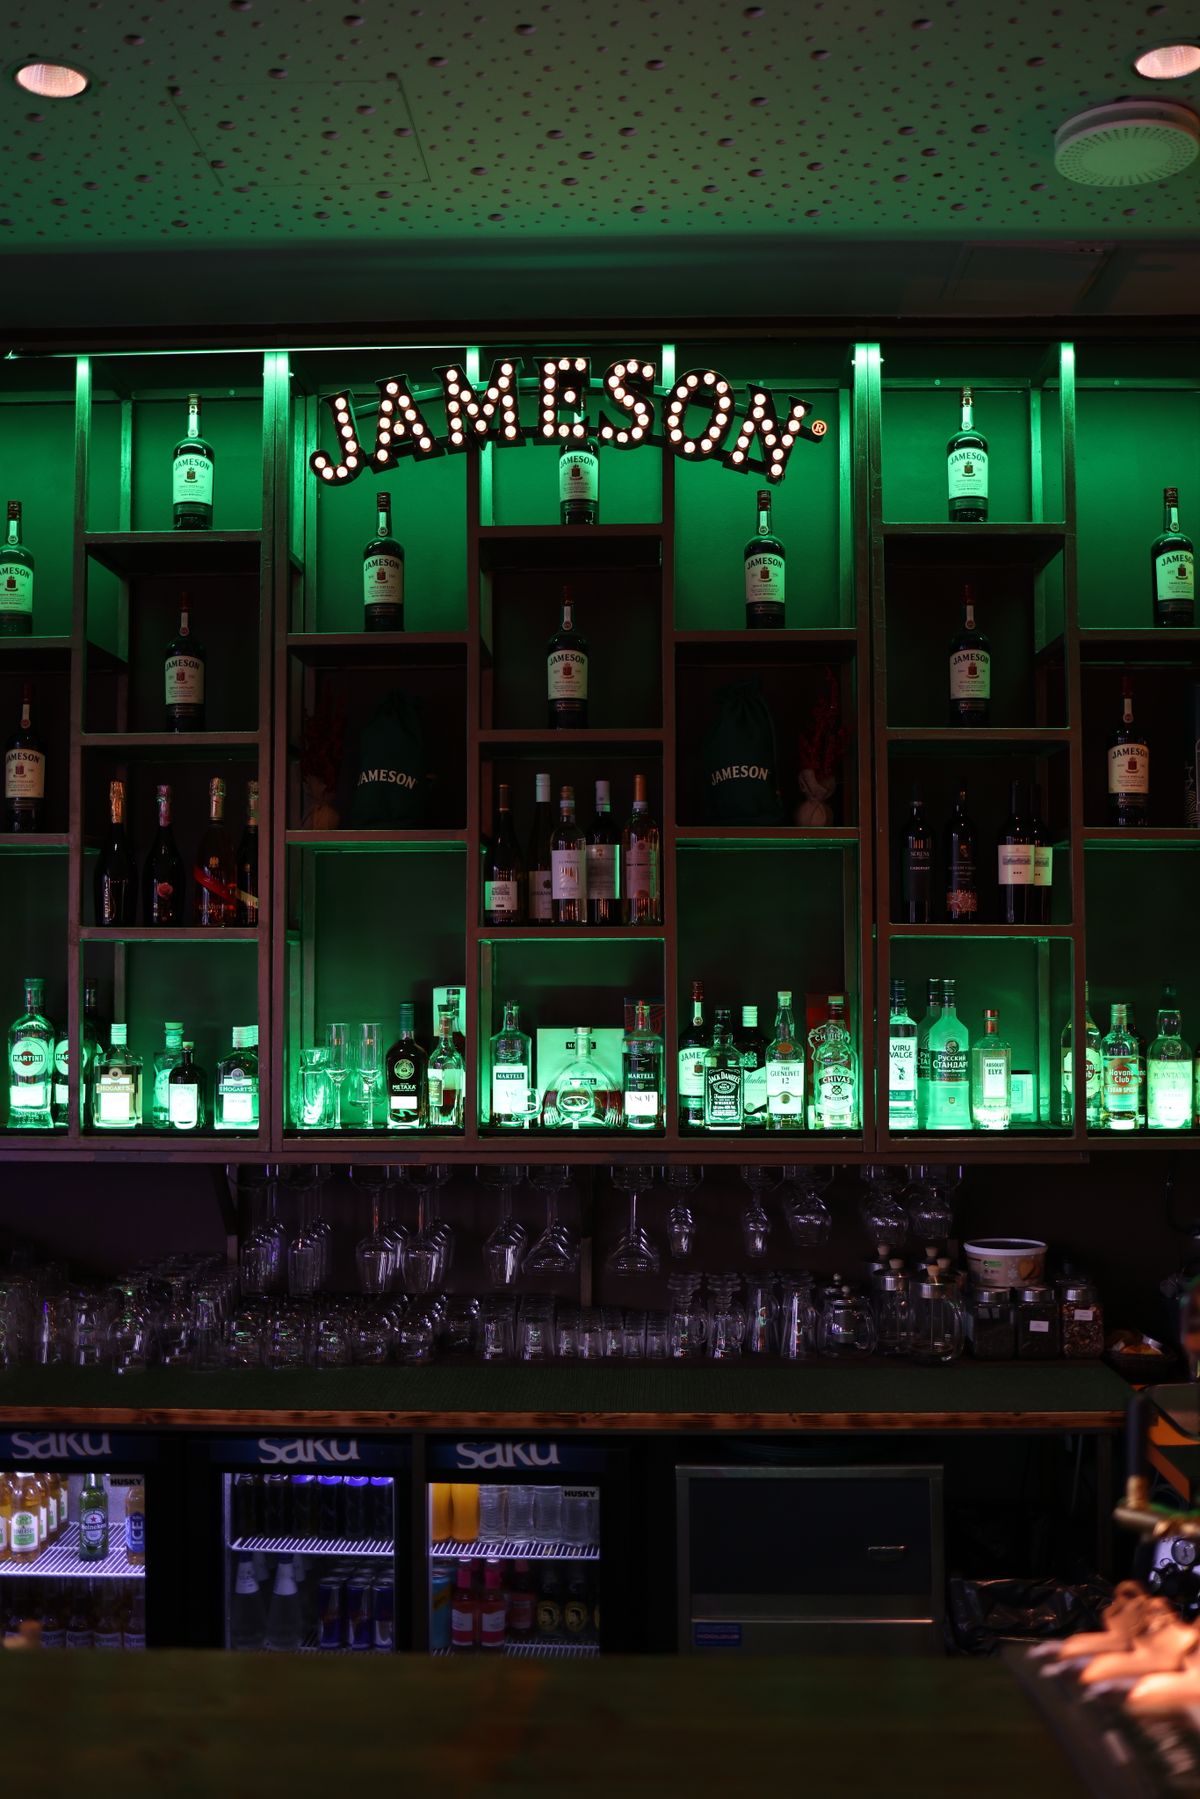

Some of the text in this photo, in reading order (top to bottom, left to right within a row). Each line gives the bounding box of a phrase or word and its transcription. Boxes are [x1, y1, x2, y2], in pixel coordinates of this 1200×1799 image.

[310, 357, 813, 485] JAMESON
[175, 459, 210, 471] JAMESON
[560, 456, 595, 469] JAMESON
[949, 453, 986, 465] JAMESON
[364, 559, 400, 572] JAMESON
[747, 557, 783, 570] JAMESON
[0, 567, 31, 580] MESON
[550, 654, 585, 666] JAMESON
[953, 653, 990, 665] JAMESON
[711, 765, 769, 786] JAMESON
[681, 1052, 708, 1062] JAME
[708, 1073, 721, 1084] JACK
[564, 1490, 595, 1498] HUSKY
